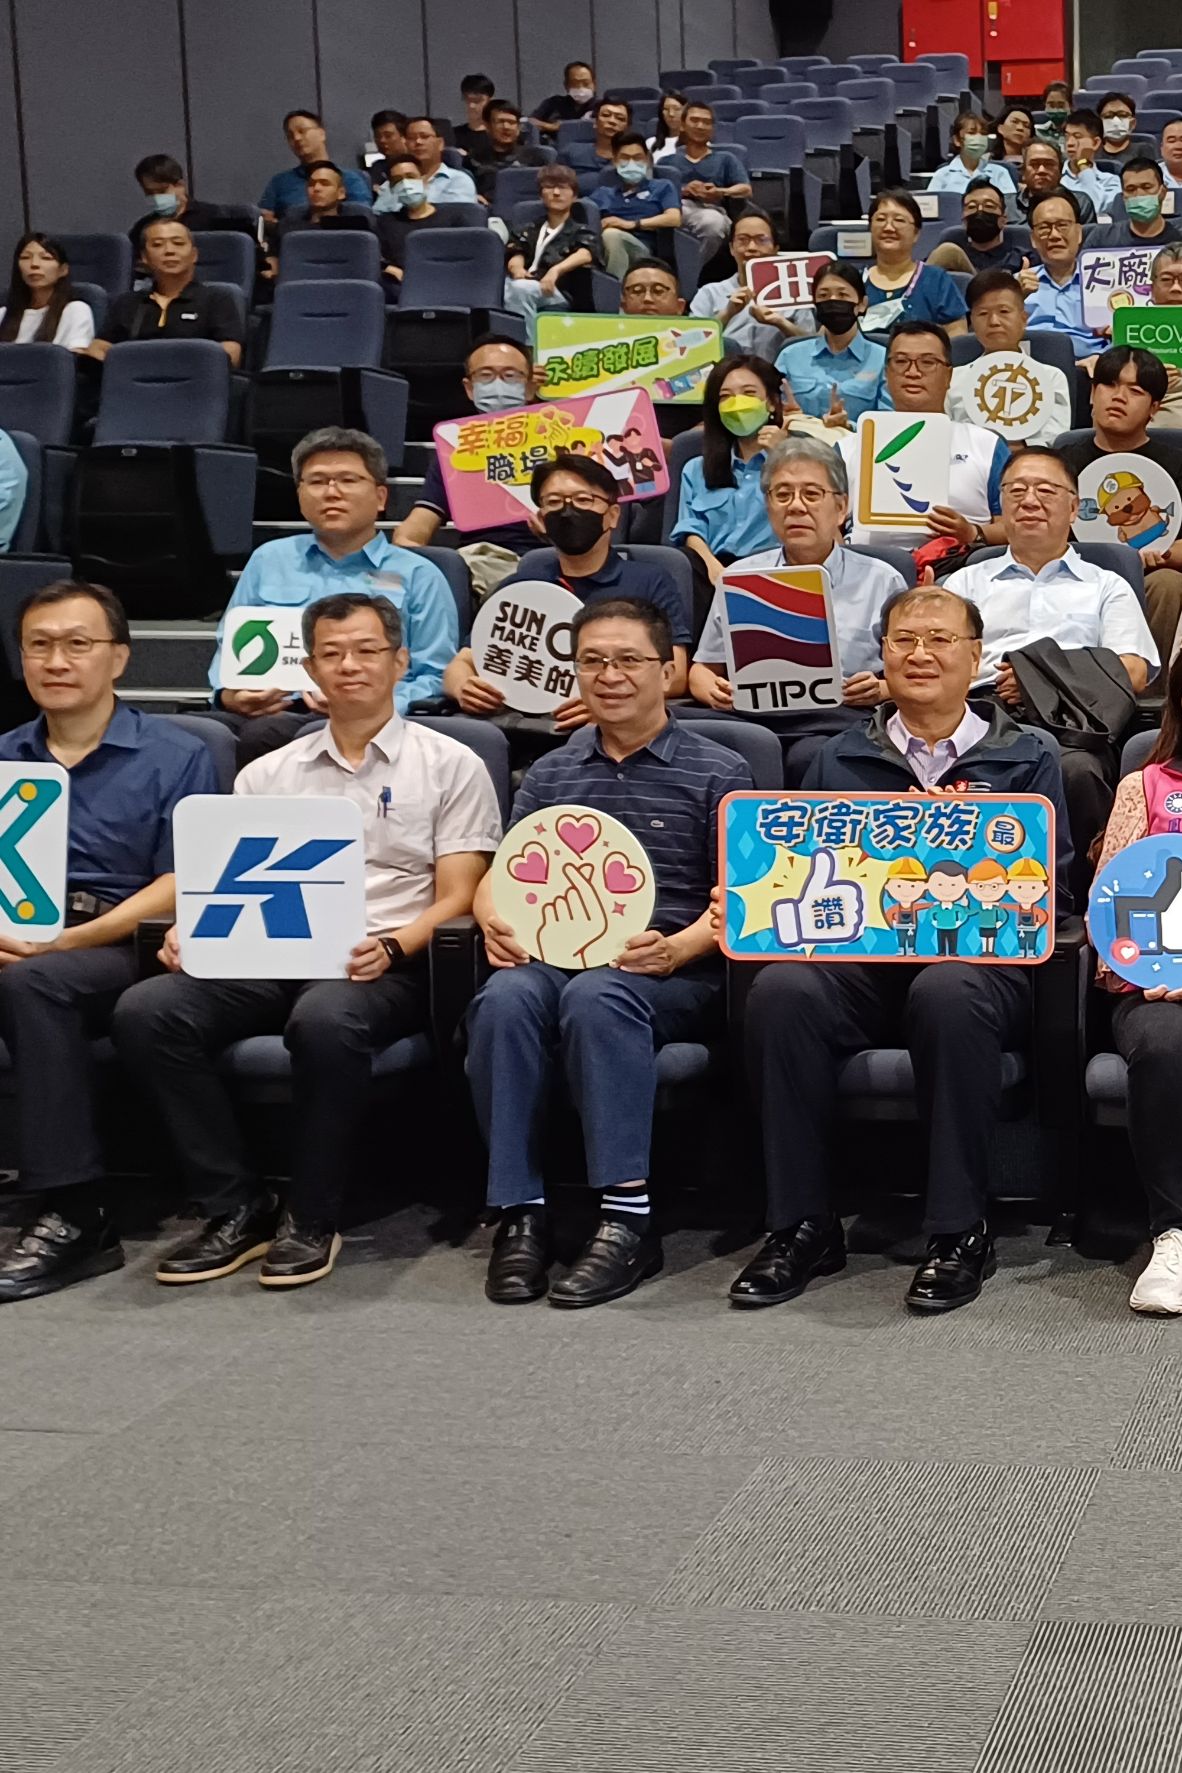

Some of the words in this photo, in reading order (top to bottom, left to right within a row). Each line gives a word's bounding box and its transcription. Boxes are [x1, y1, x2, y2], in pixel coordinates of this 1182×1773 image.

[544, 336, 659, 386] 永續發展
[456, 413, 528, 455] 幸福
[495, 600, 546, 635] SUN
[490, 622, 540, 653] MAKE
[483, 644, 576, 698] 善美的
[737, 677, 838, 710] TIPC
[758, 800, 979, 850] 安衛家族
[990, 819, 1016, 847] 最
[811, 896, 846, 930] 讚
